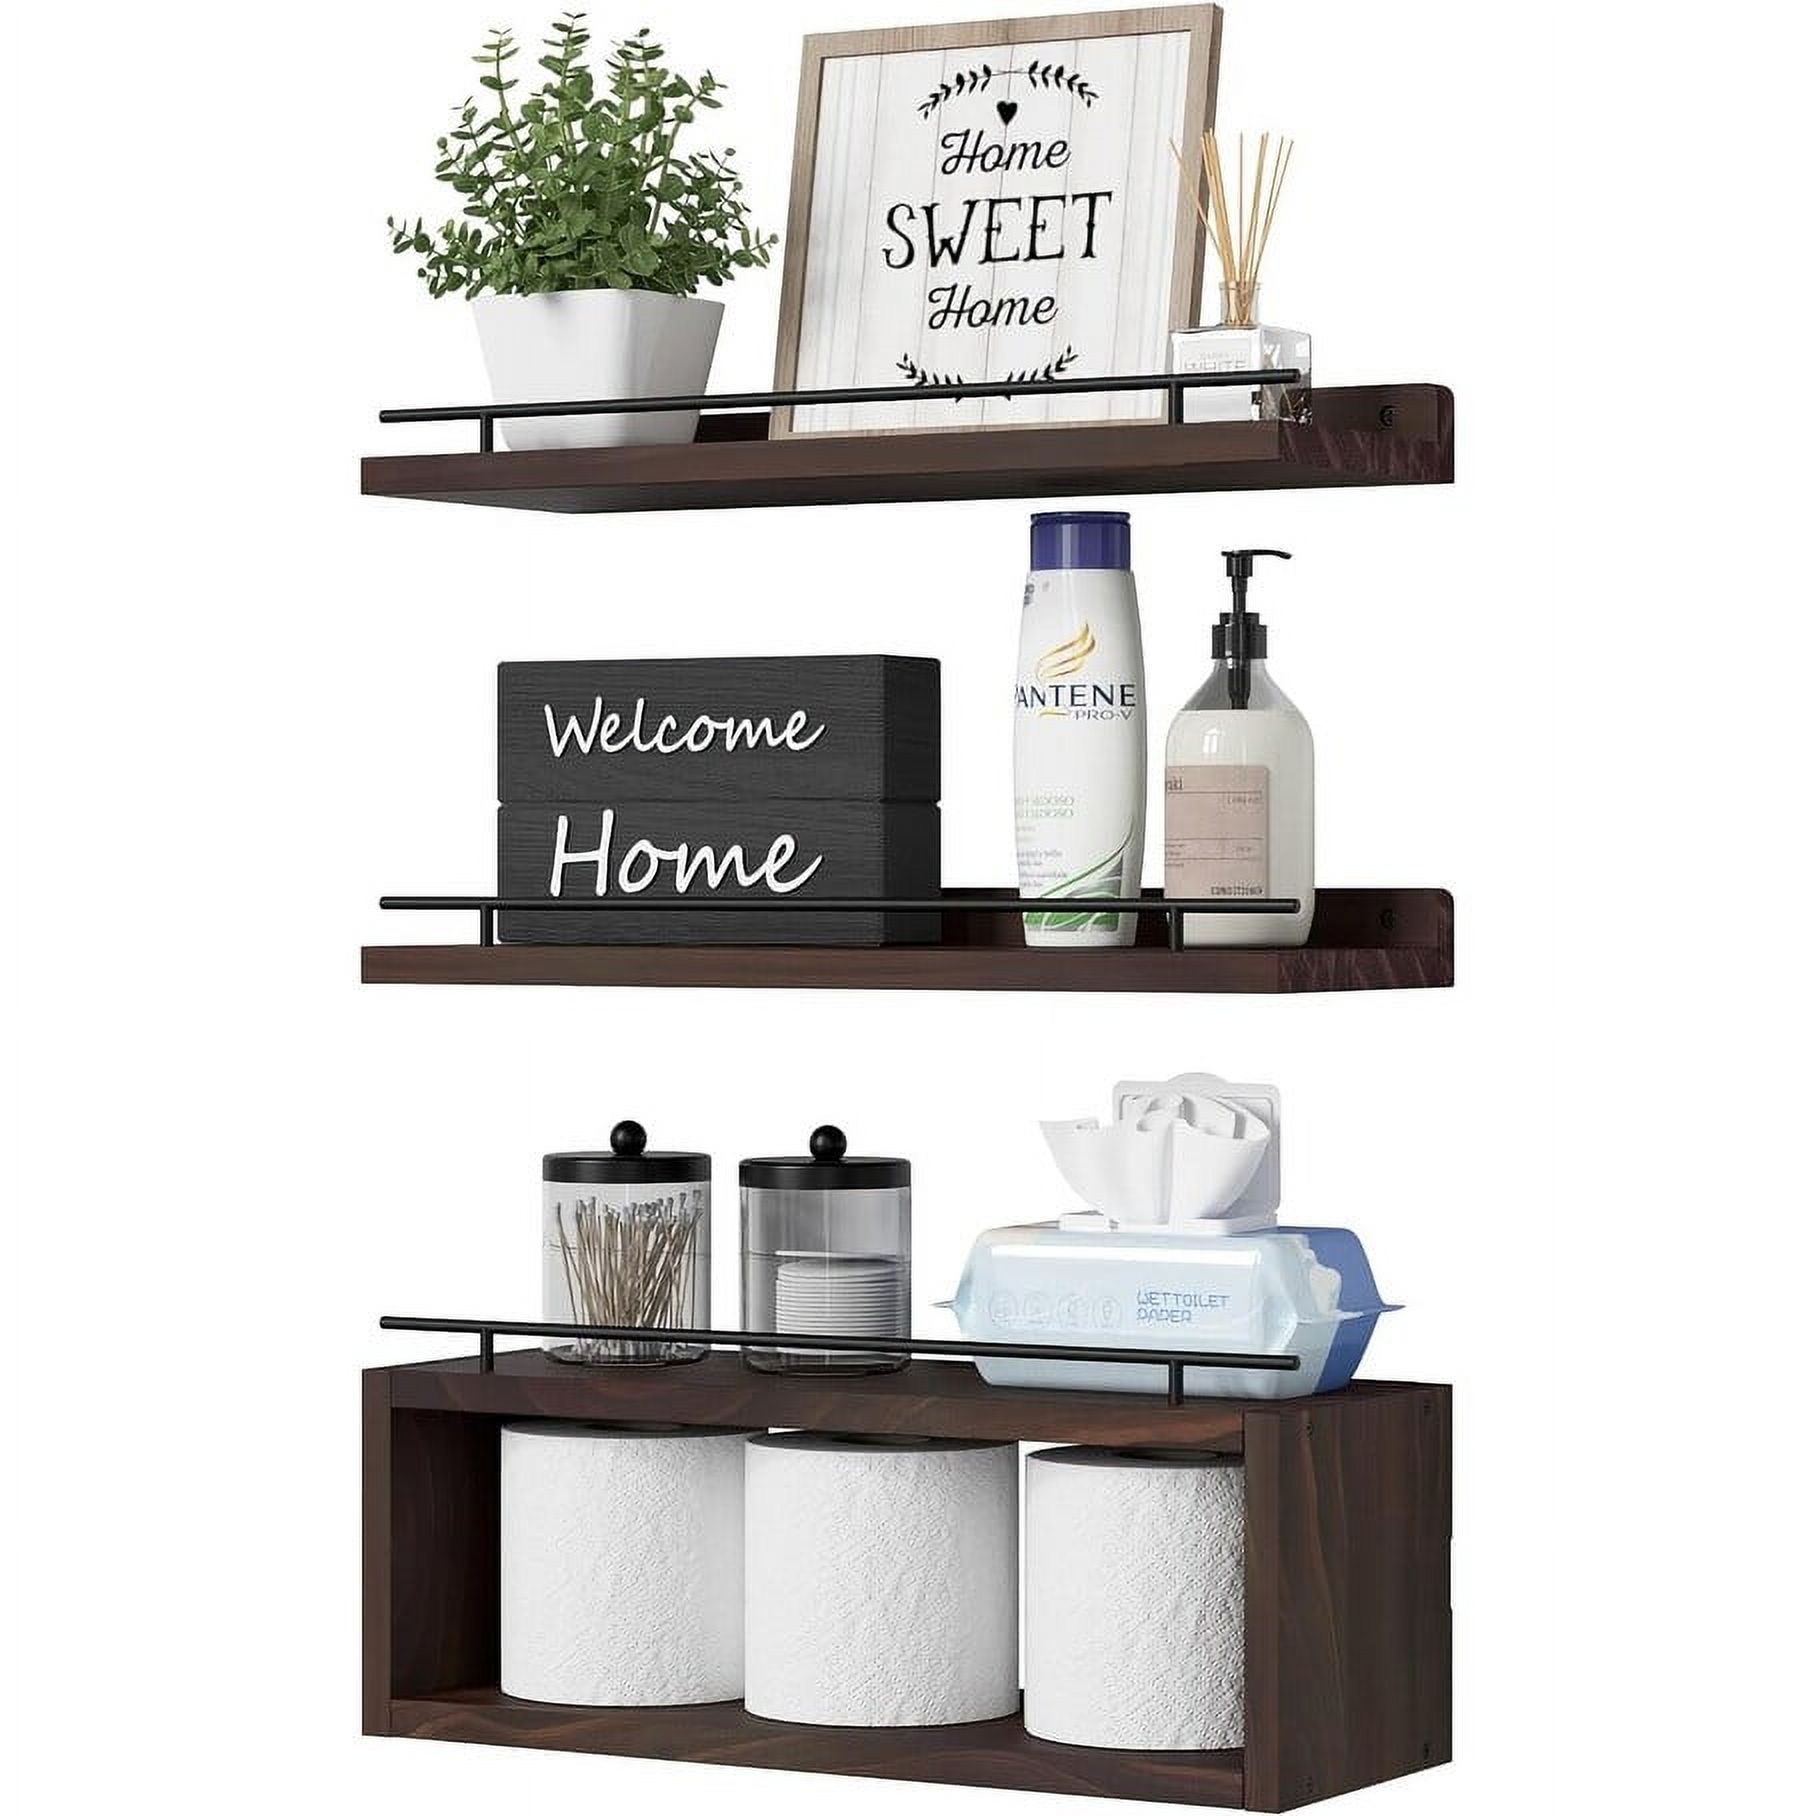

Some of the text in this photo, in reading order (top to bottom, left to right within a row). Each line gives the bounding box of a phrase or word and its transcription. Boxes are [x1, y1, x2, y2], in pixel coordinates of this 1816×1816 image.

[941, 128, 1071, 175] Home
[882, 190, 1113, 269] SWEET
[928, 282, 1058, 331] Home
[543, 695, 826, 759] Welcome
[549, 808, 823, 897] Home
